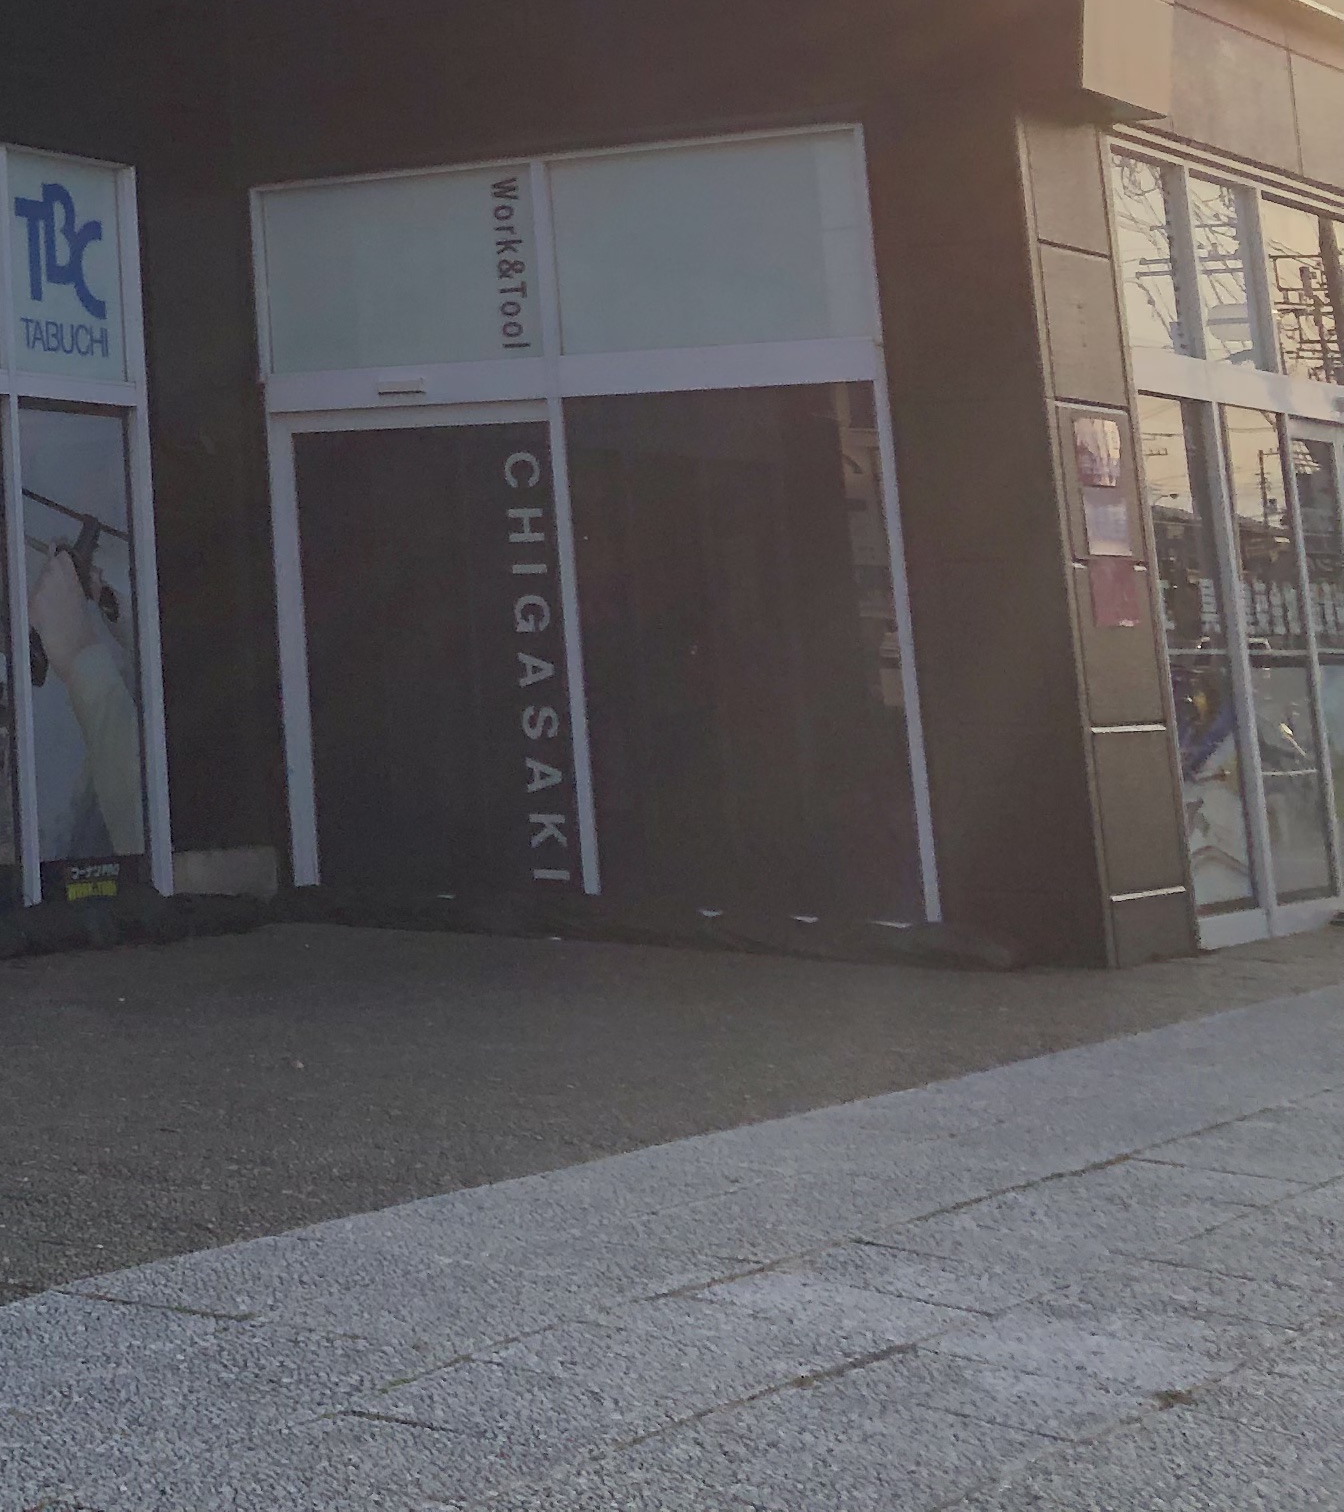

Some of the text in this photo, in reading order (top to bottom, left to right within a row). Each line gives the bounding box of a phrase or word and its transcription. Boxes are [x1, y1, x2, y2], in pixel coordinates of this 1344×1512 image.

[20, 316, 110, 359] TABUCHI
[490, 176, 532, 350] Work&Tool
[503, 450, 571, 882] CHIGASAKI
